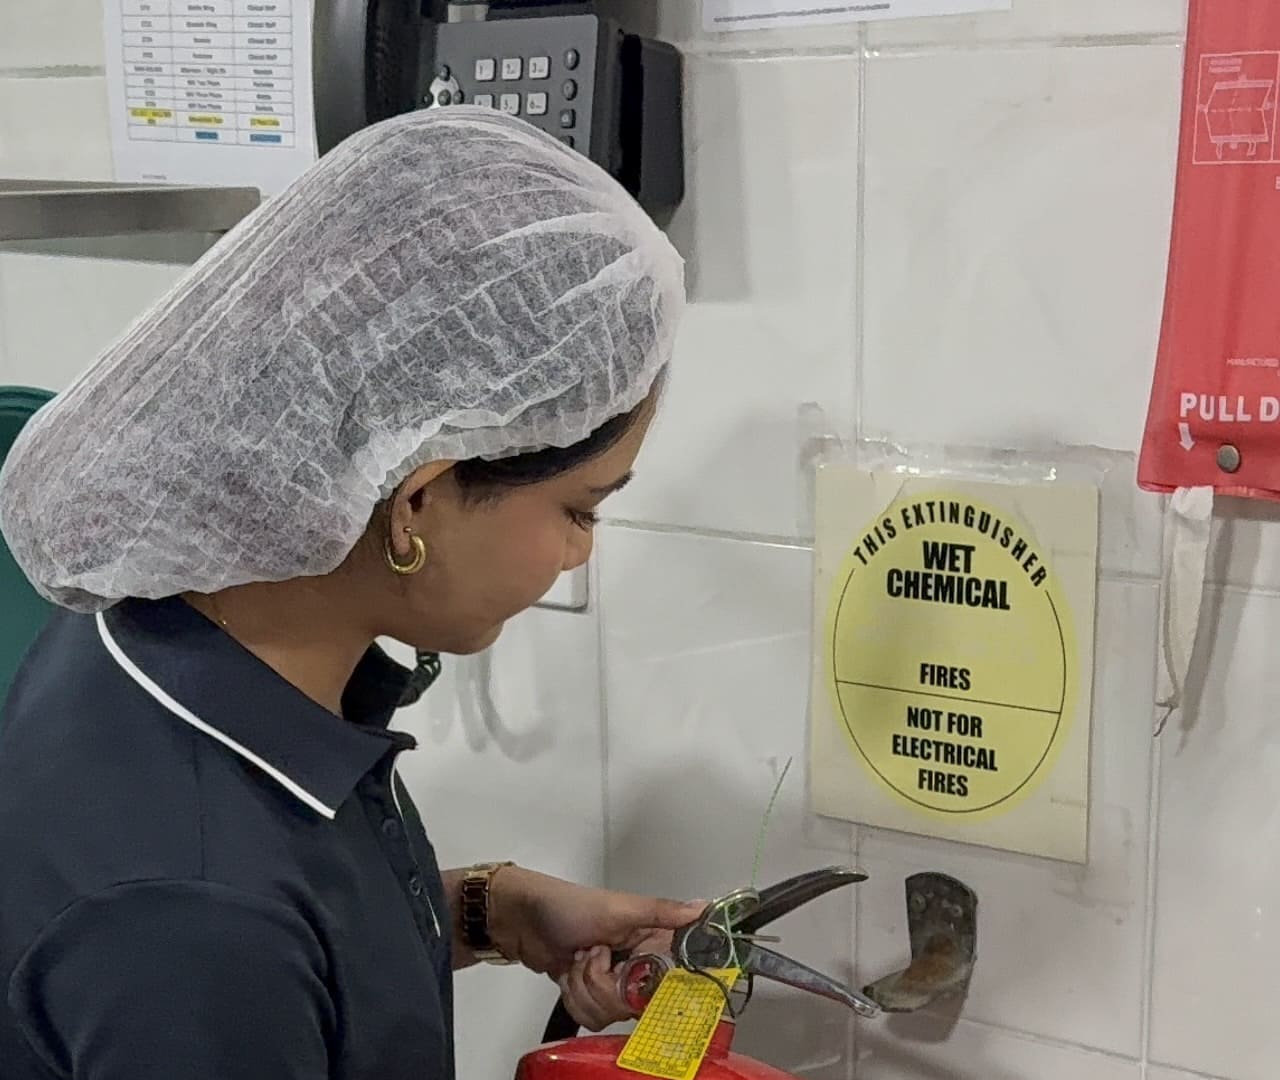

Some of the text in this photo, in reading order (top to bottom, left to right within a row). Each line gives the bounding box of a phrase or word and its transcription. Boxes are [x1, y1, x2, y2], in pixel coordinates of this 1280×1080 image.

[1180, 393, 1252, 423] PULL
[853, 500, 1047, 588] THIS EXTINGUISHER
[923, 540, 975, 574] WET
[887, 569, 1010, 611] CHEMICAL
[920, 663, 971, 691] FIRES
[907, 706, 983, 738] NOT FOR
[892, 735, 998, 771] ELECTRICAL
[918, 770, 968, 797] FIRES
